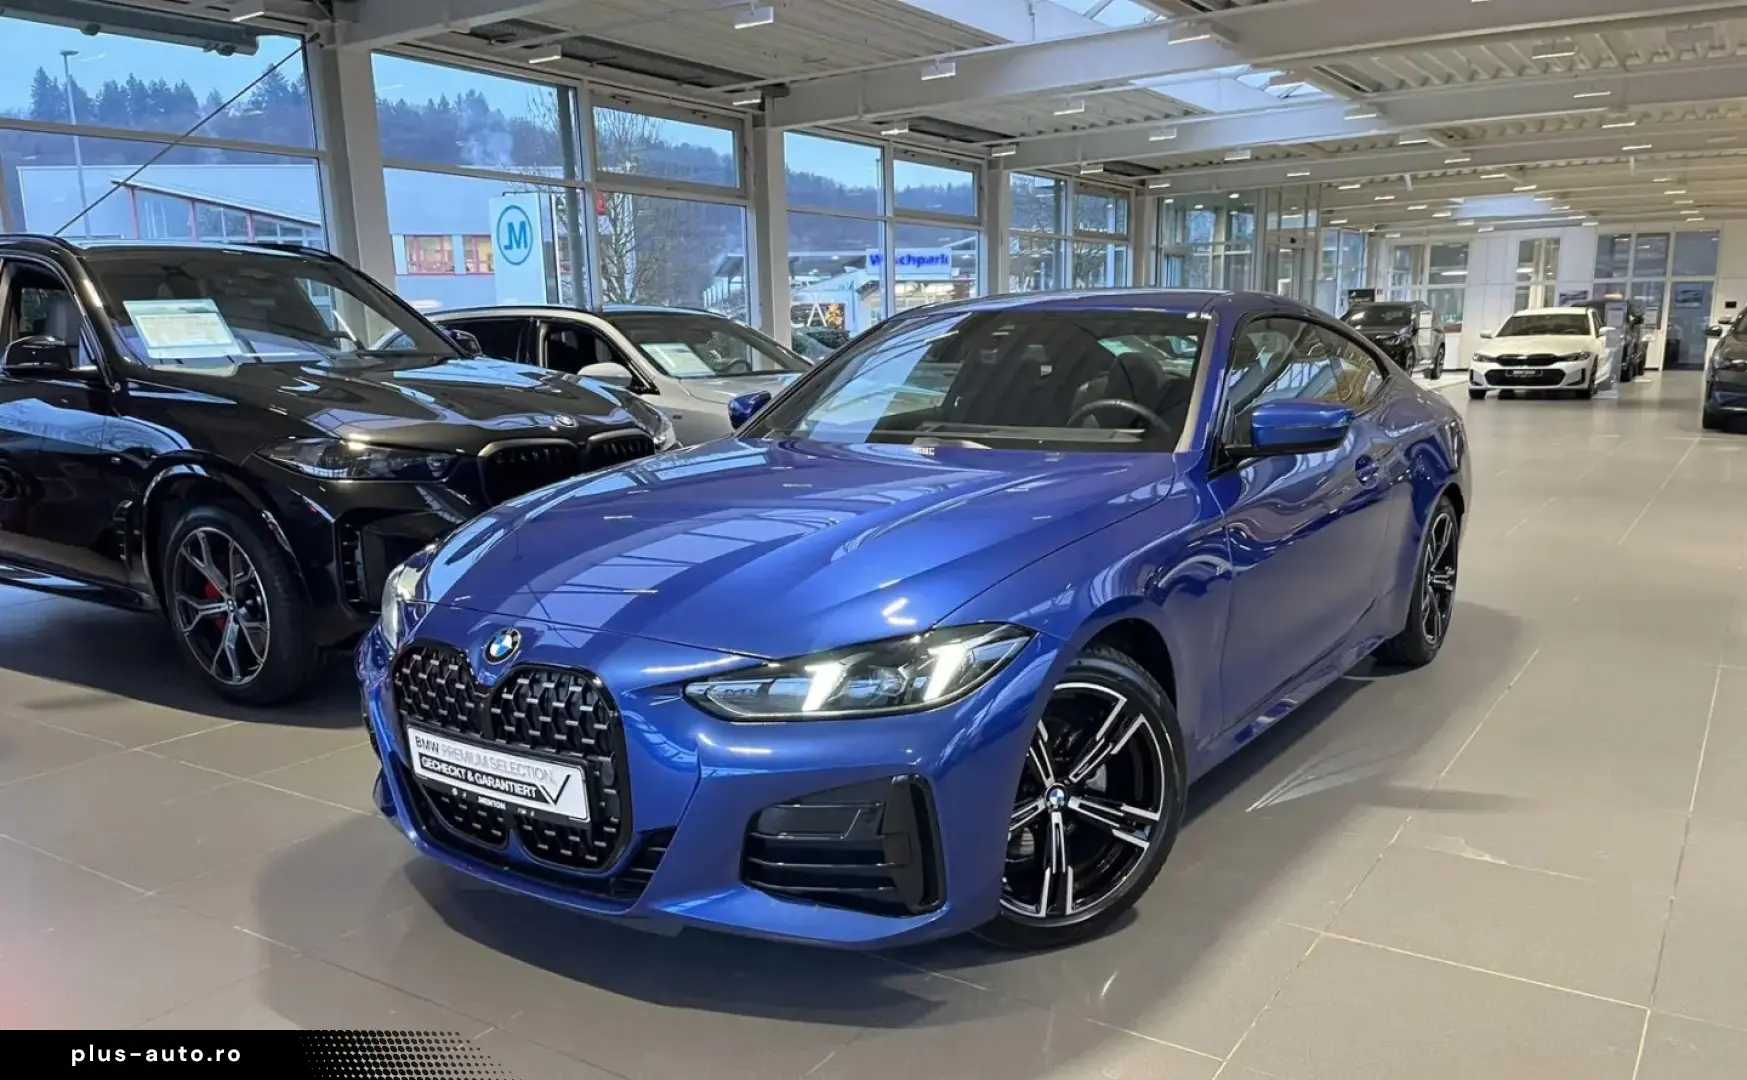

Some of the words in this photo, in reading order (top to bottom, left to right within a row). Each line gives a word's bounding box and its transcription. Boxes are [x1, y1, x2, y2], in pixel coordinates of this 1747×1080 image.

[869, 253, 949, 268] Wchpark
[415, 735, 439, 754] BMW
[441, 744, 488, 767] PREMIUM
[489, 756, 557, 785] SELECTION
[421, 757, 466, 779] GECHECKT
[466, 771, 474, 783] &
[475, 773, 537, 798] GARANTIERT
